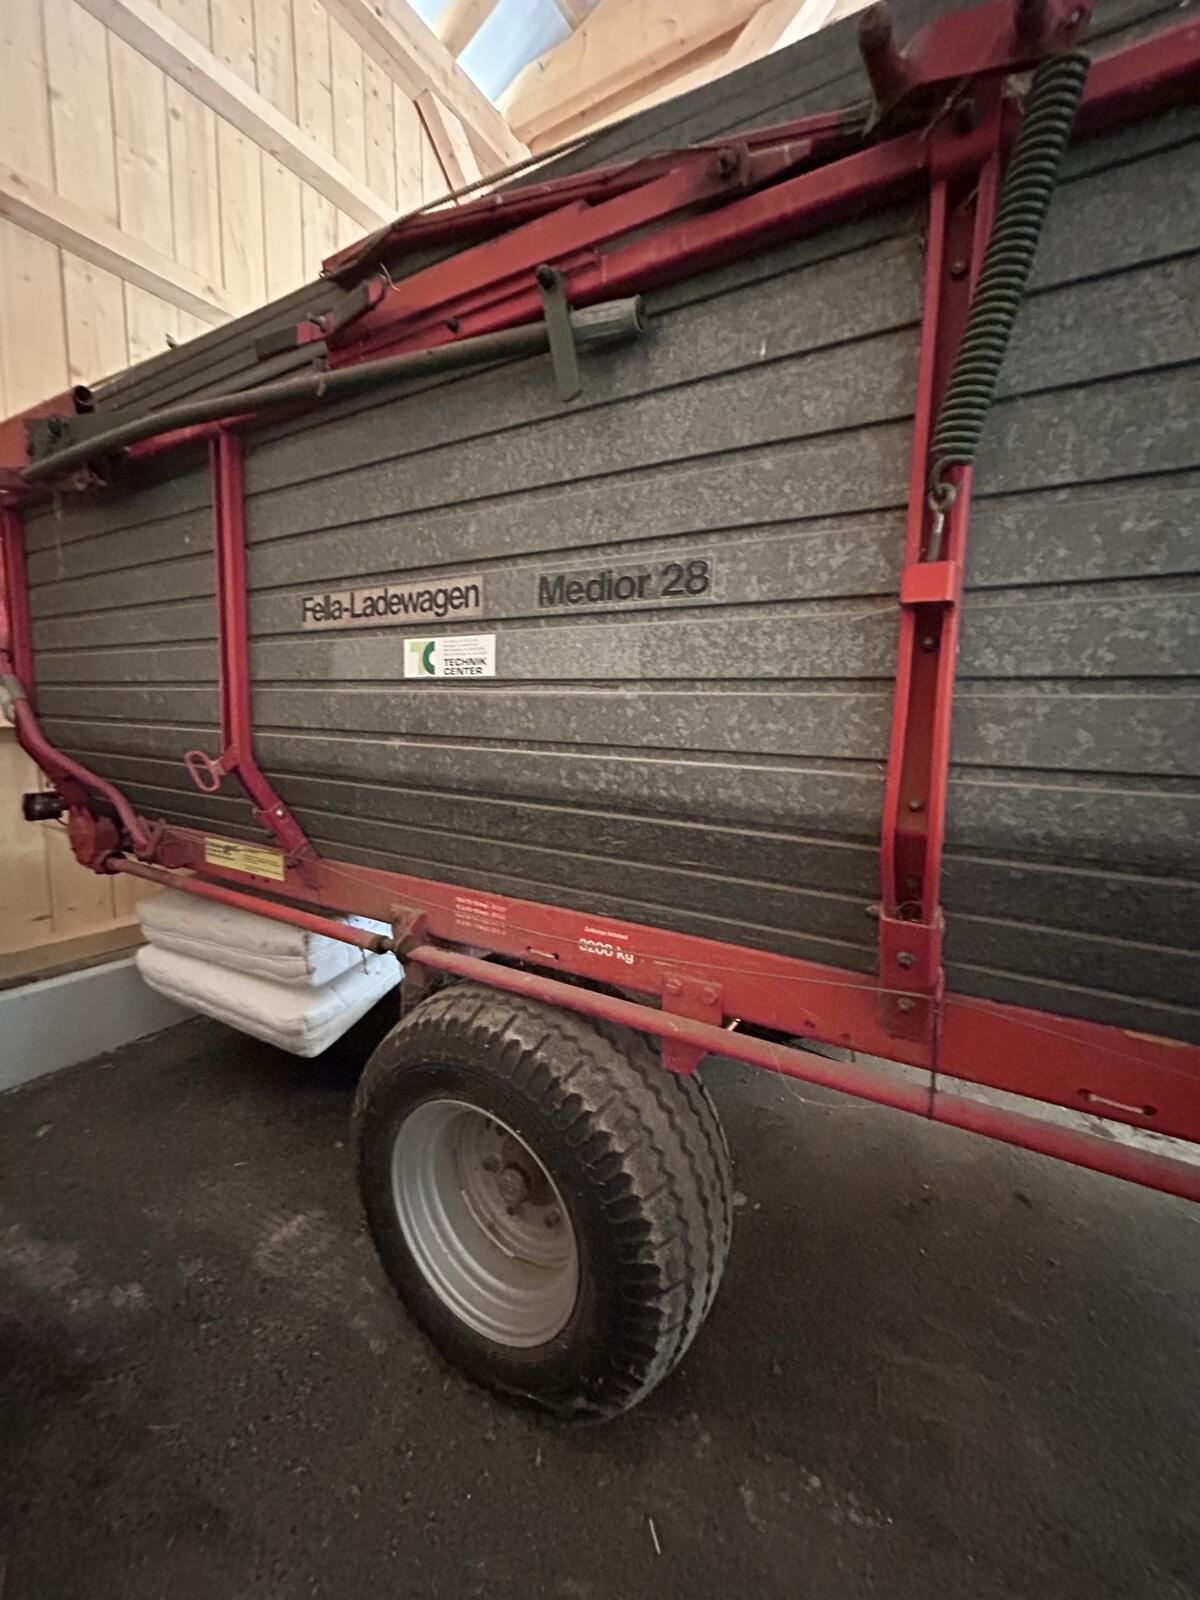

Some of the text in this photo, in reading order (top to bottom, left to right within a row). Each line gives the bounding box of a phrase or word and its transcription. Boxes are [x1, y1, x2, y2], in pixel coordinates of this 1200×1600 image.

[538, 560, 709, 606] Medior 28
[302, 584, 480, 622] Fella-Ladewagen
[443, 657, 488, 667] TECHNIK
[443, 666, 483, 676] CENTER
[616, 946, 634, 964] kg
